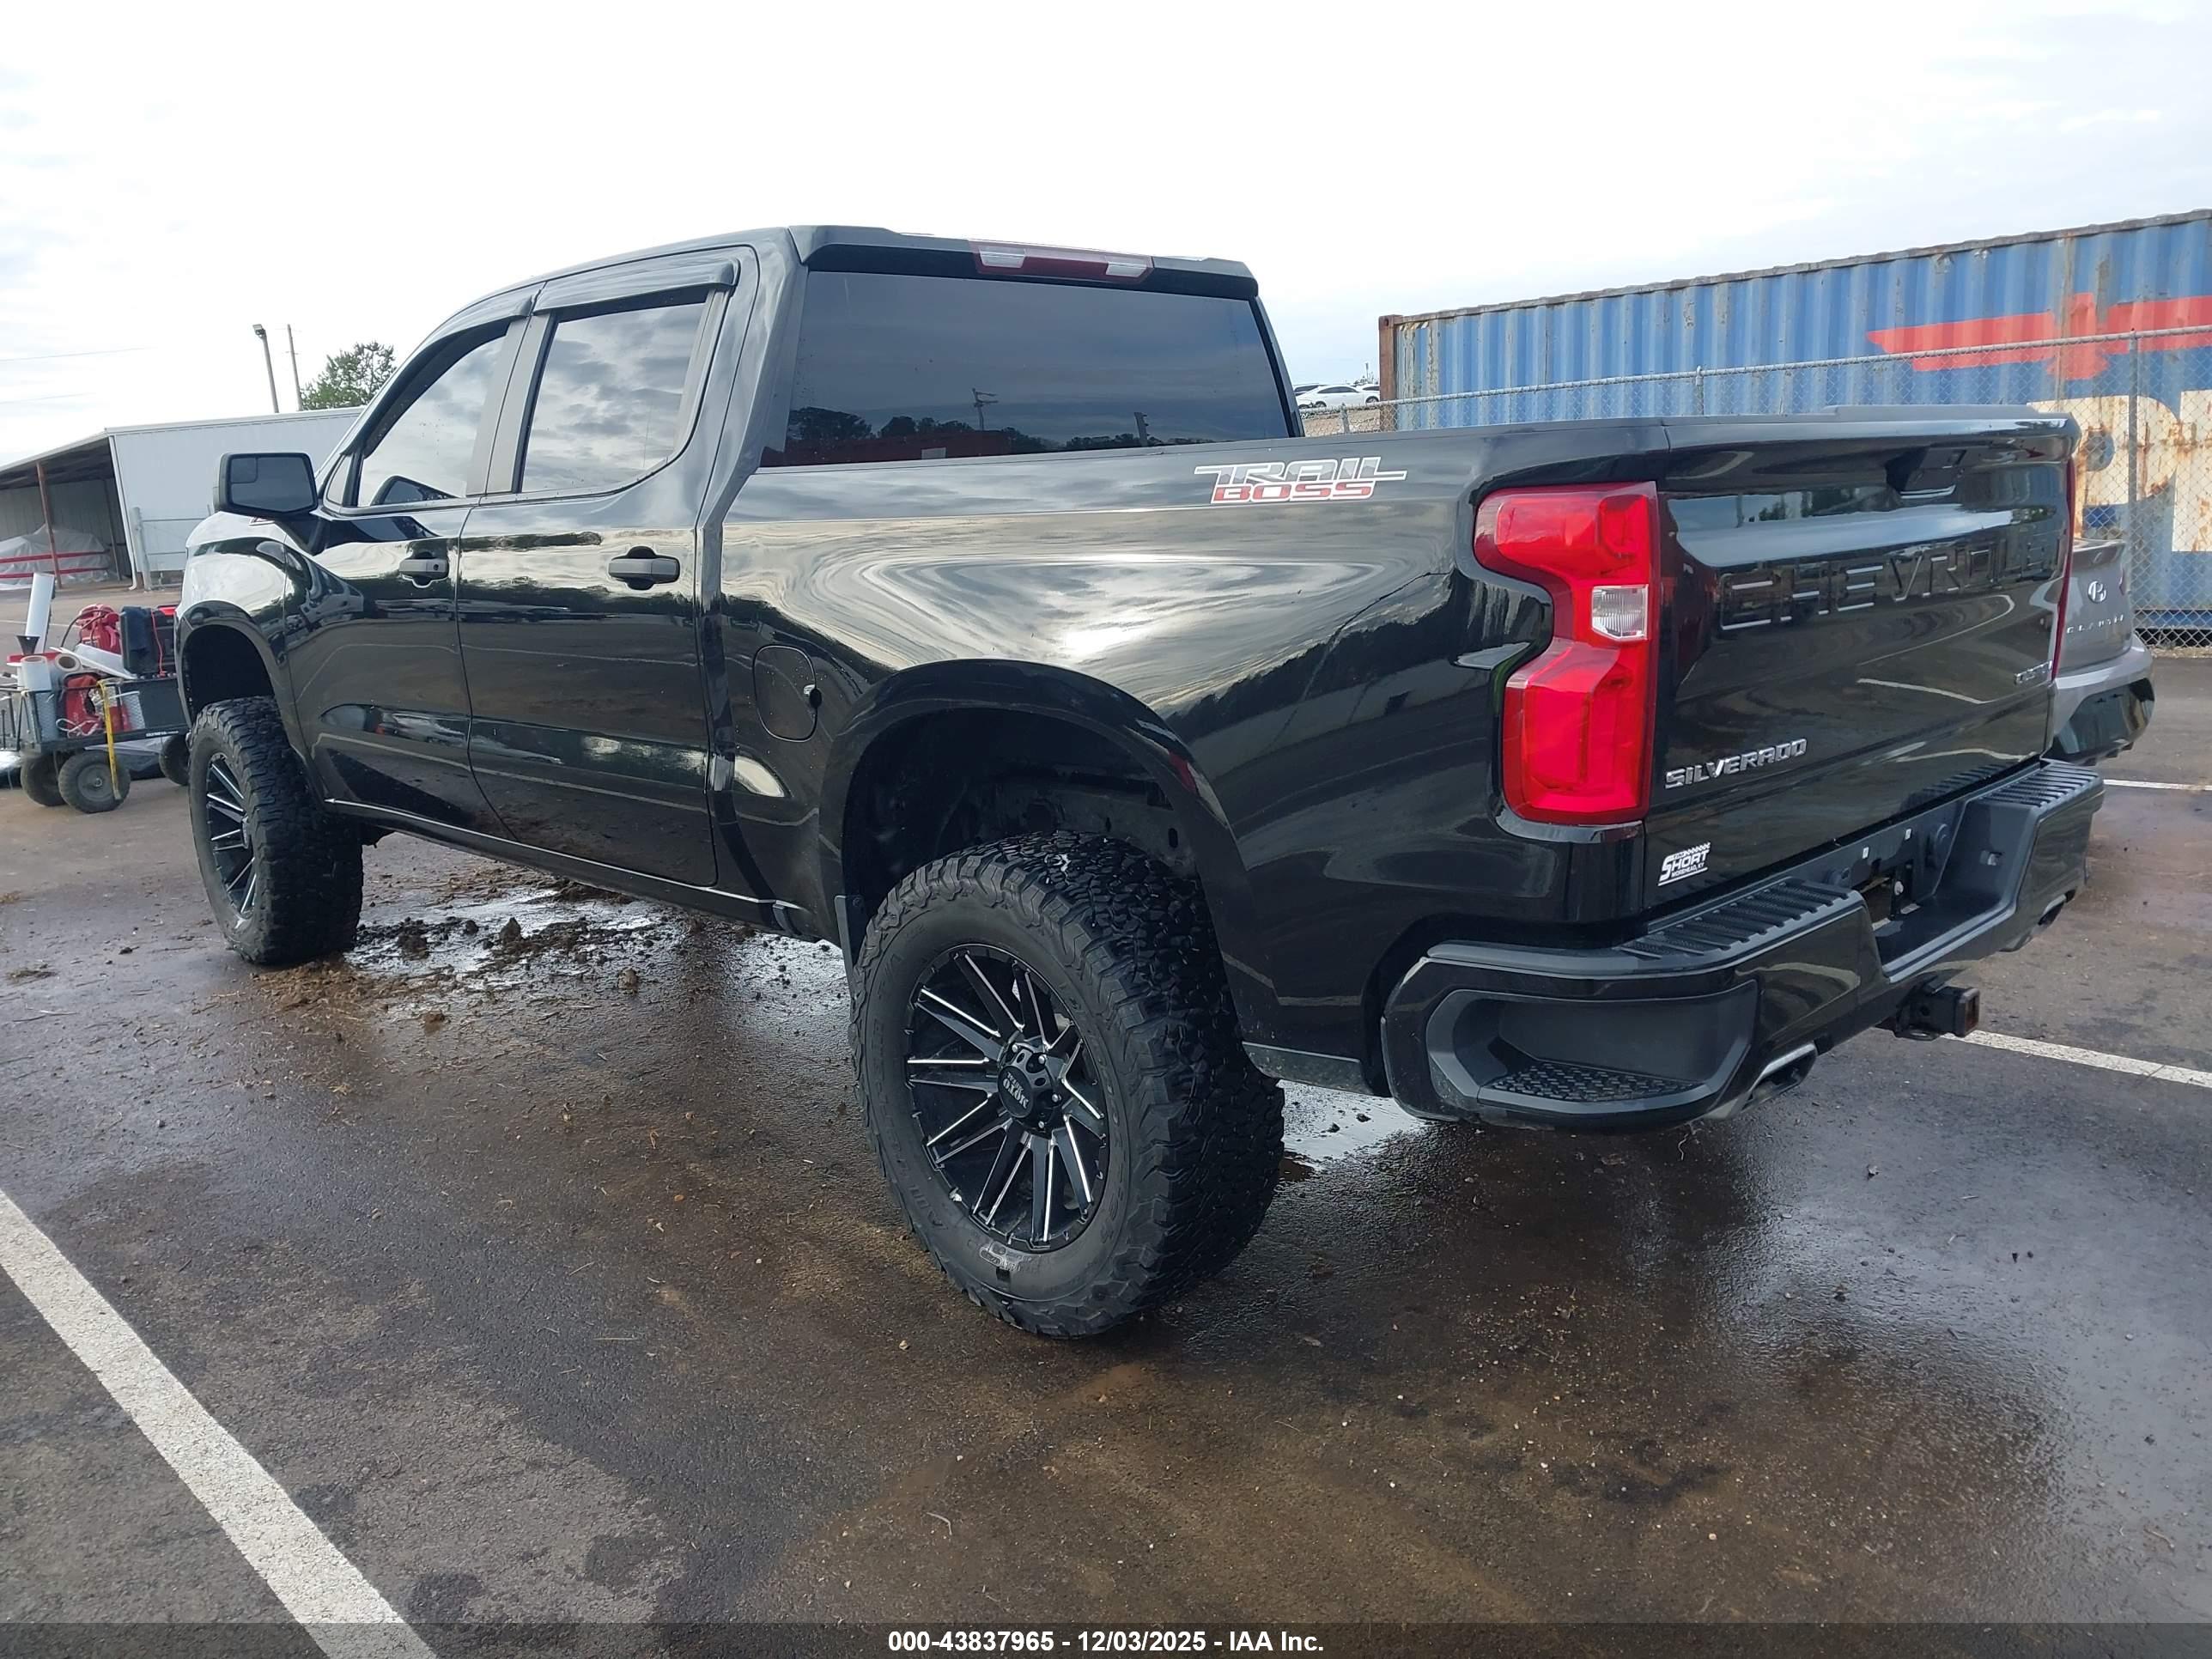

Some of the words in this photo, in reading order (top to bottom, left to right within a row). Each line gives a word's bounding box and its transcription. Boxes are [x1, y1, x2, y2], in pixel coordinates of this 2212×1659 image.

[1194, 456, 1407, 485] TRAIL
[1211, 480, 1374, 503] BOSS
[1665, 738, 1808, 789] SILVERADO
[1659, 849, 1710, 882] SHORT
[1003, 1078, 1029, 1109] MOTO
